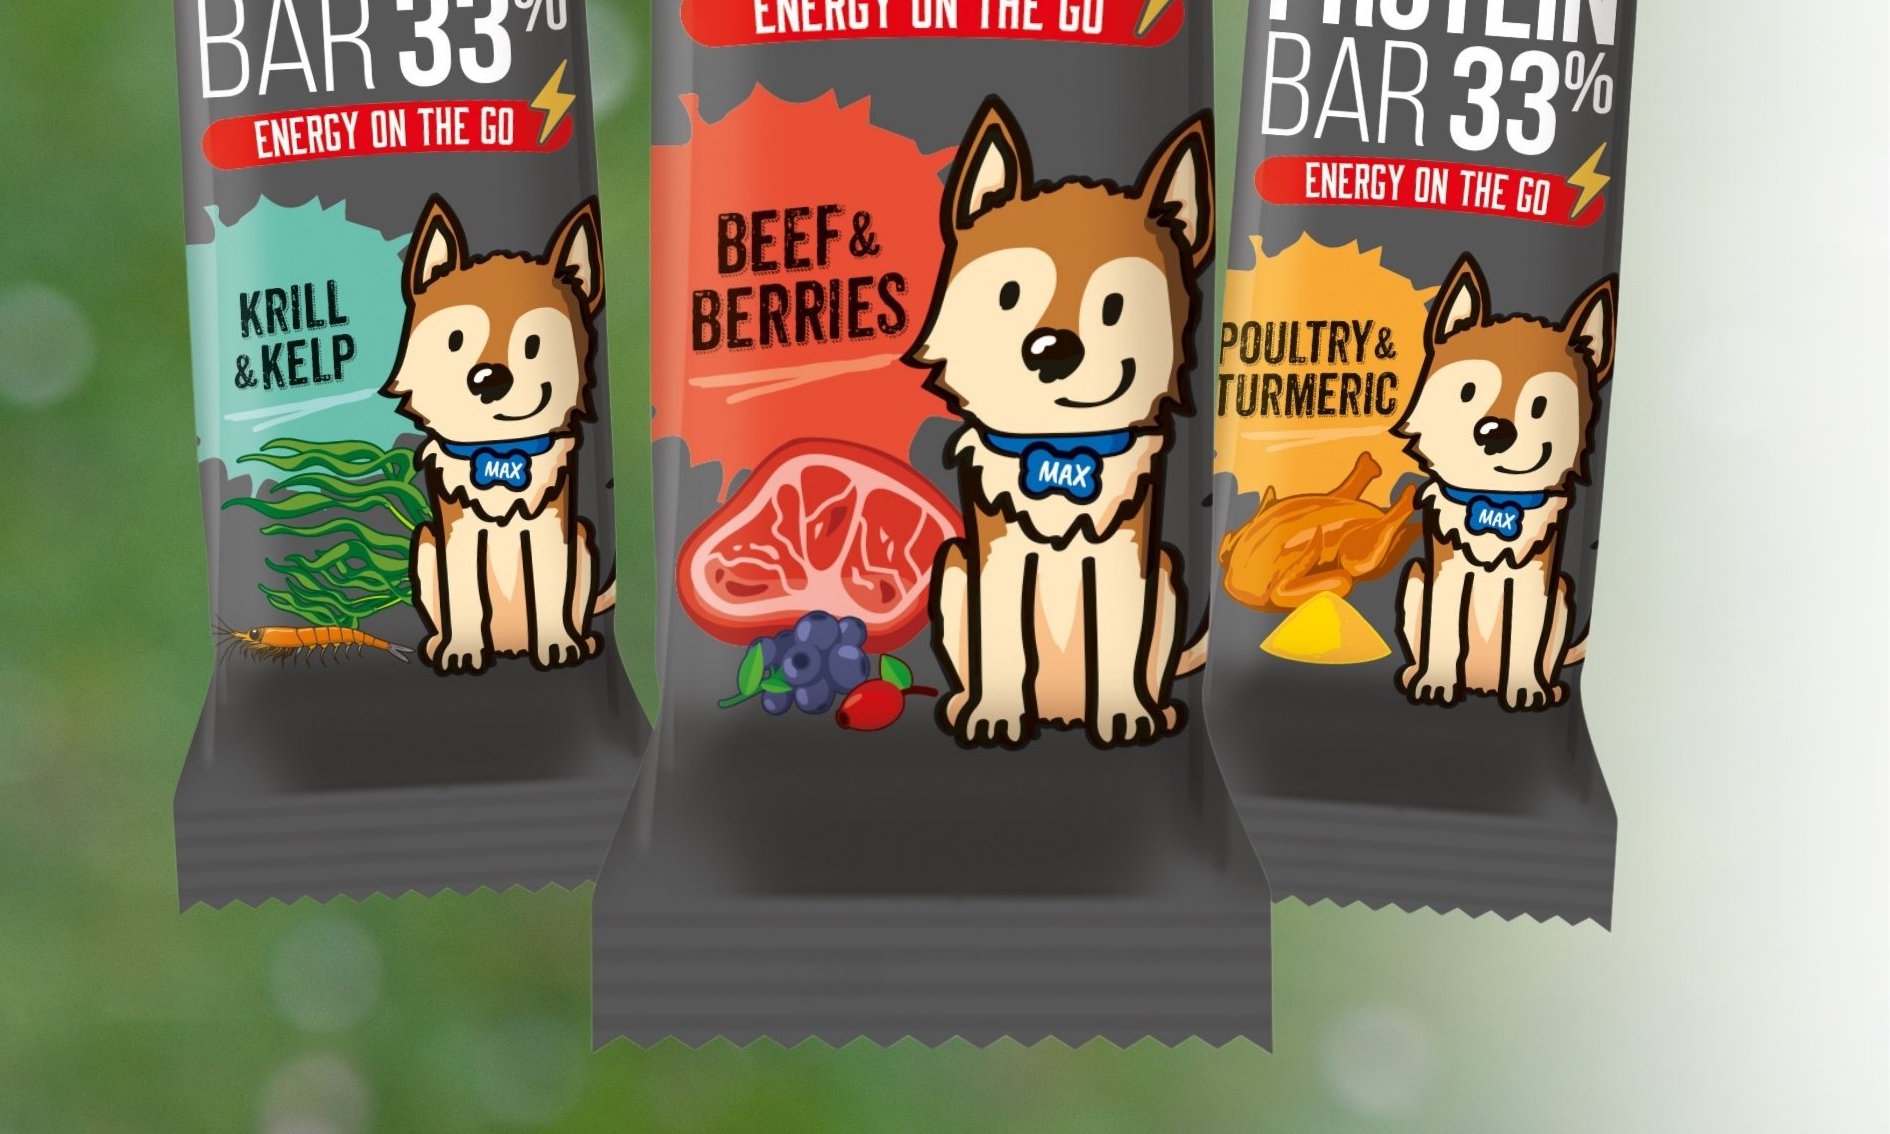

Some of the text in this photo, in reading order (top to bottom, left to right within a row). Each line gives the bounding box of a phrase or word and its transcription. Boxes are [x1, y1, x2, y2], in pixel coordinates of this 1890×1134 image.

[1261, 31, 1614, 156] BAR 33%
[254, 106, 514, 159] ENERGY ON THE GO
[1306, 161, 1550, 216] ENERGY ON THE GO
[238, 279, 351, 339] KRILL
[692, 272, 910, 355] BERRIES
[1218, 371, 1398, 417] TURMERIC
[484, 461, 523, 480] MAX
[1038, 460, 1091, 489] MAX
[1478, 508, 1516, 530] MAX
